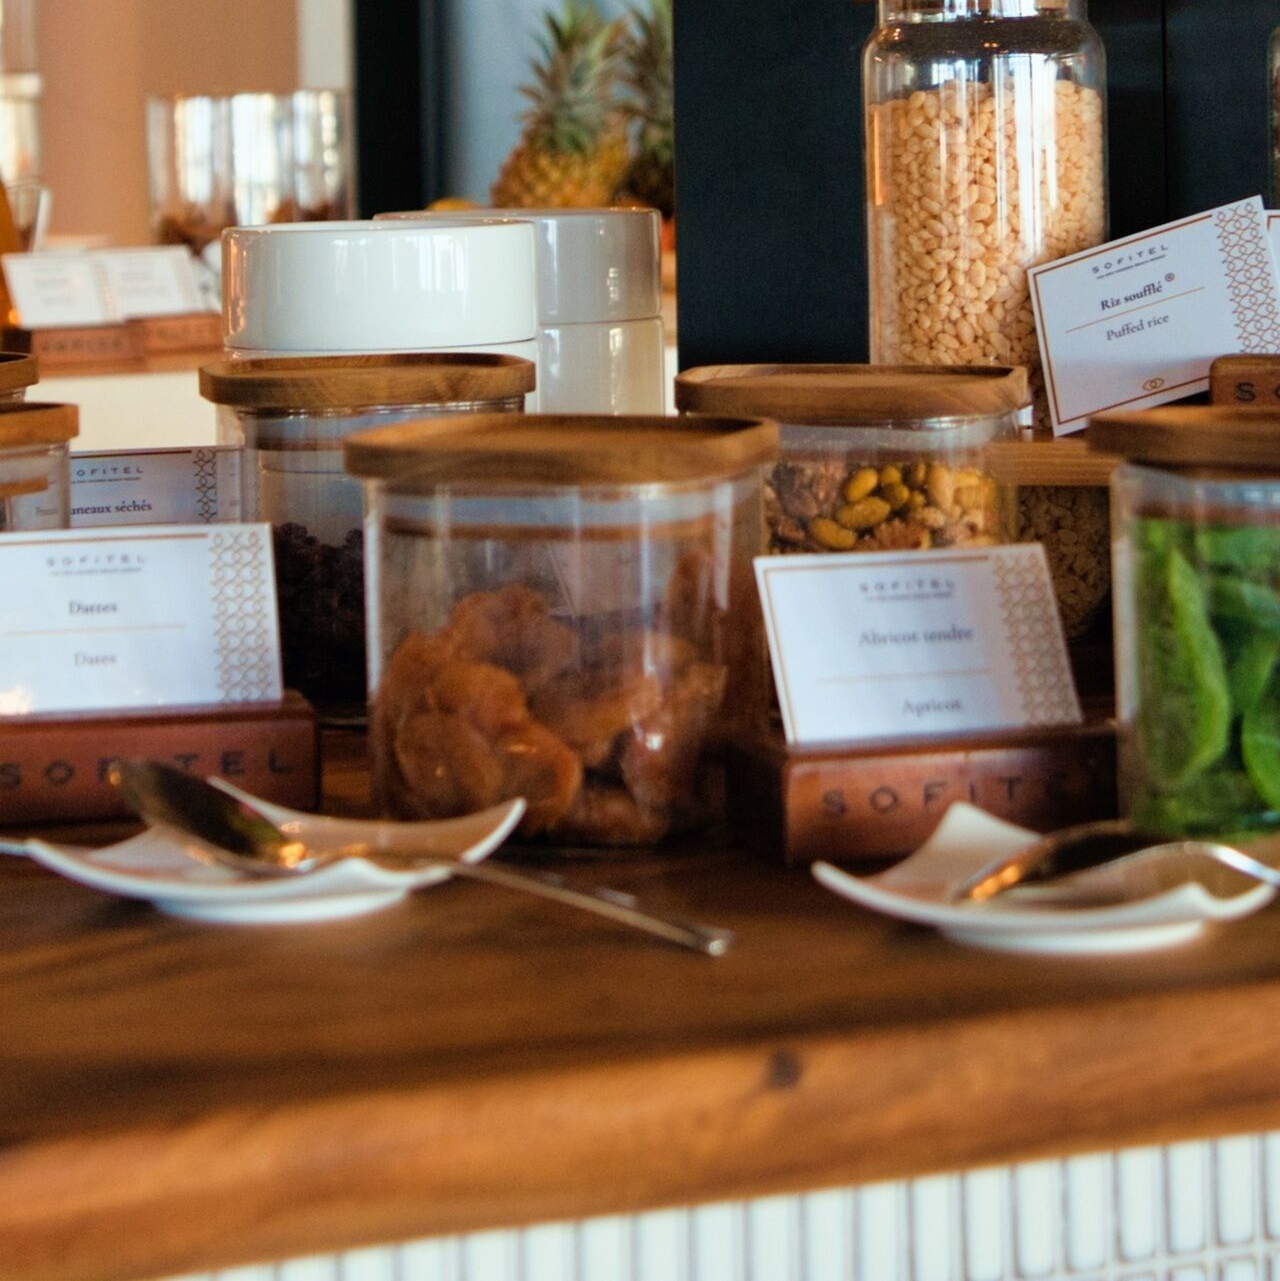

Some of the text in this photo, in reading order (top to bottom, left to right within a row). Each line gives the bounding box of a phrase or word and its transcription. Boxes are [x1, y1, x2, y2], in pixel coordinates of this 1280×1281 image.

[1092, 244, 1169, 274] SOFITEL
[1100, 298, 1122, 311] Riz
[1123, 281, 1163, 304] soufflé
[1106, 315, 1170, 341] Puffed rice
[76, 466, 145, 477] OFITEL
[70, 503, 112, 516] uneaux
[114, 499, 153, 513] séchés
[46, 554, 145, 567] SOFITEL
